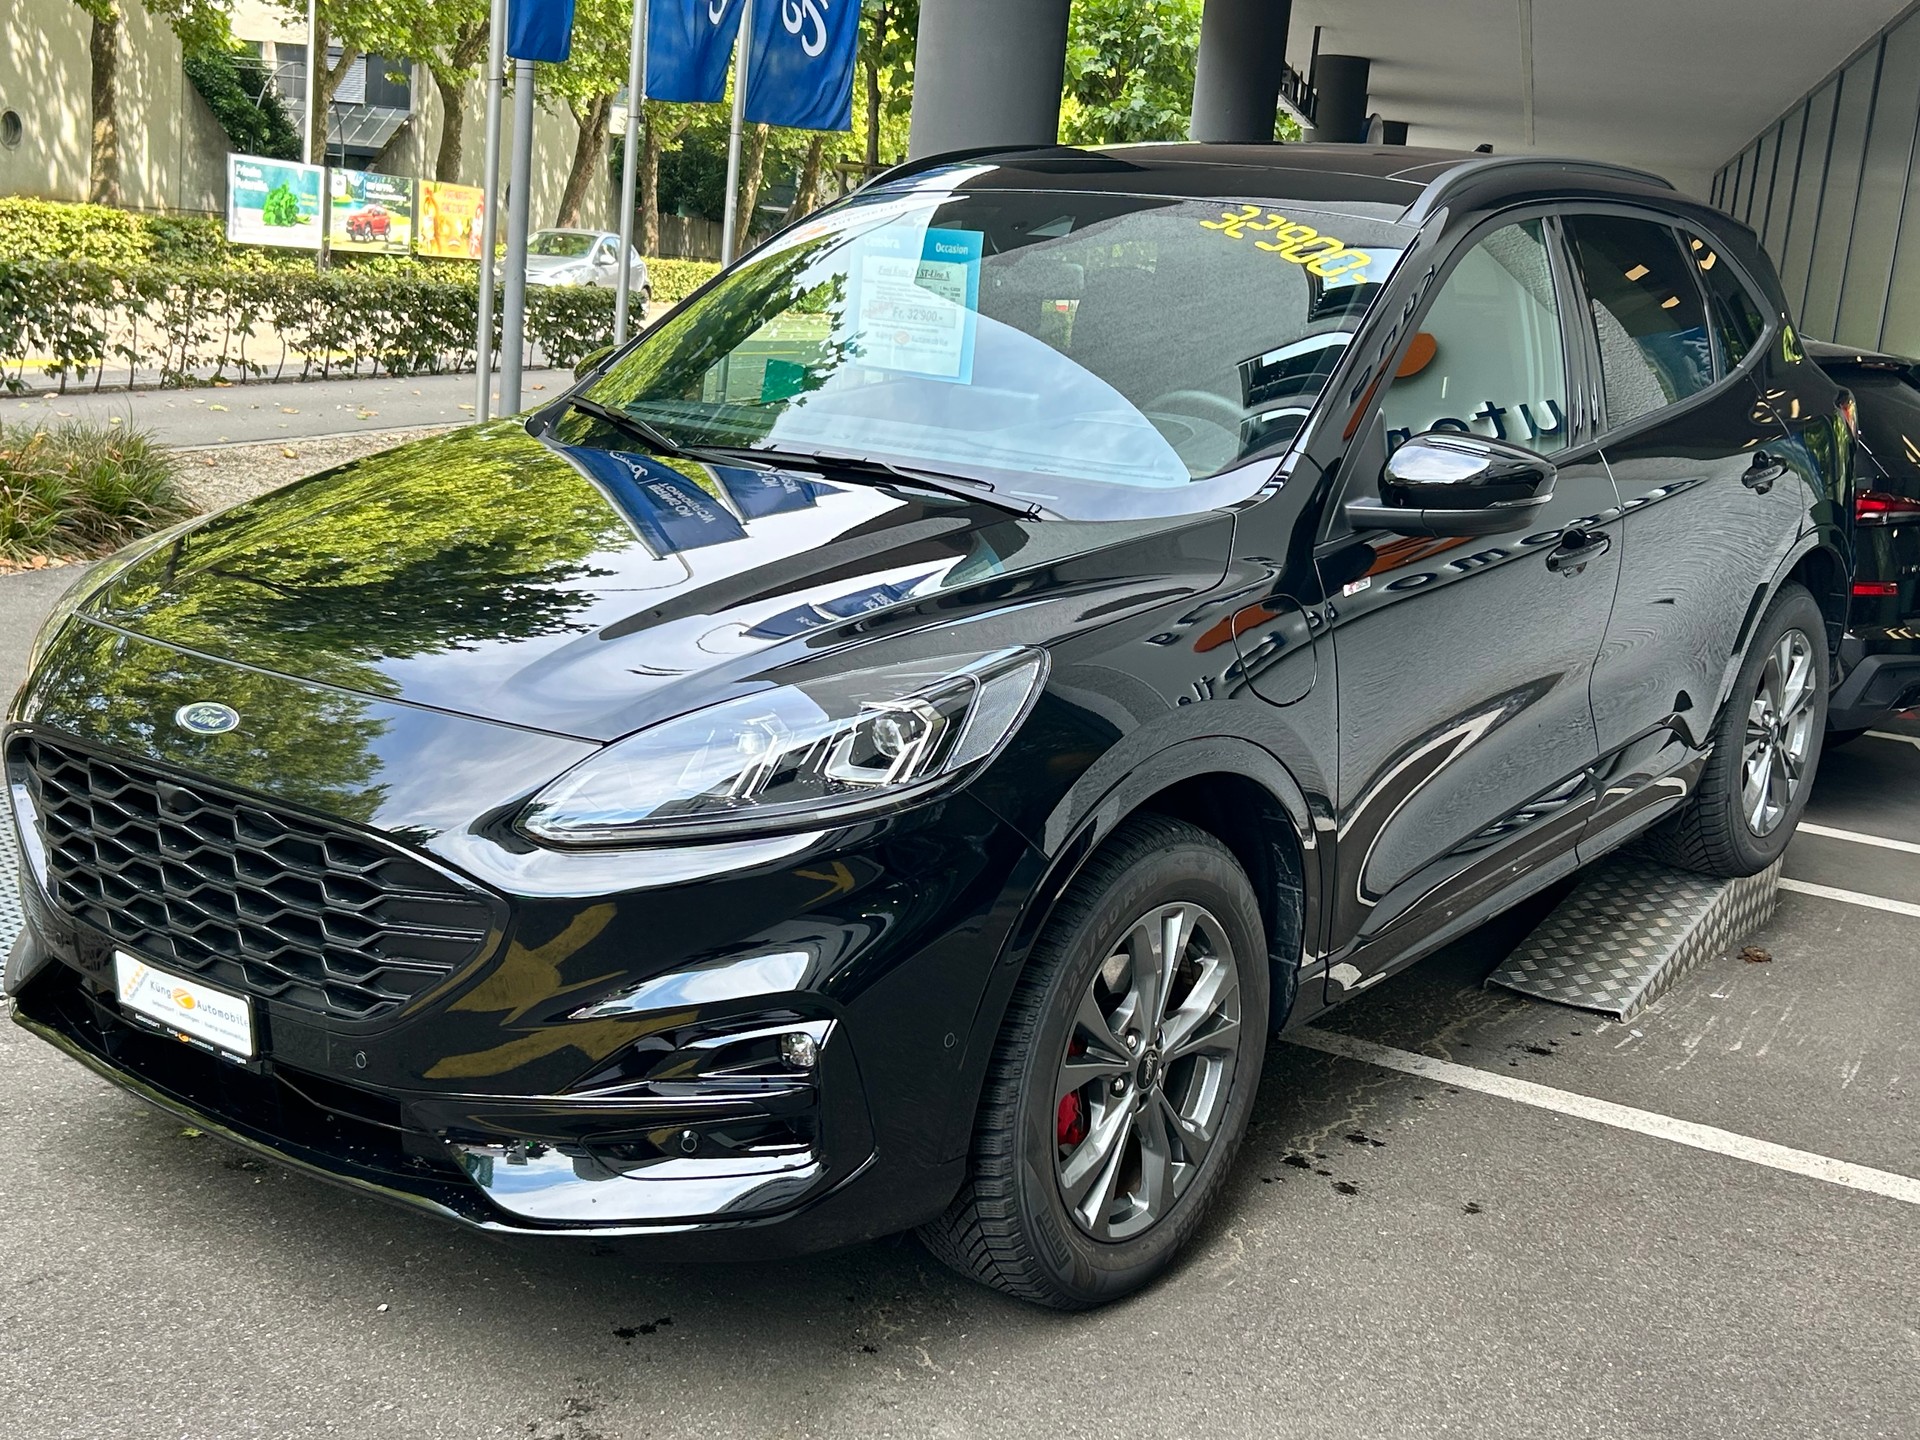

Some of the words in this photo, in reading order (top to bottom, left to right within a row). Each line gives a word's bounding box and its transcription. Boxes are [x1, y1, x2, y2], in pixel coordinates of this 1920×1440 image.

[935, 242, 969, 255] Occasion
[920, 268, 945, 280] ST-Line
[945, 271, 952, 280] X
[892, 307, 906, 319] Fr.
[189, 707, 228, 728] Ford
[149, 980, 172, 1000] Küng
[196, 999, 249, 1029] Automobile
